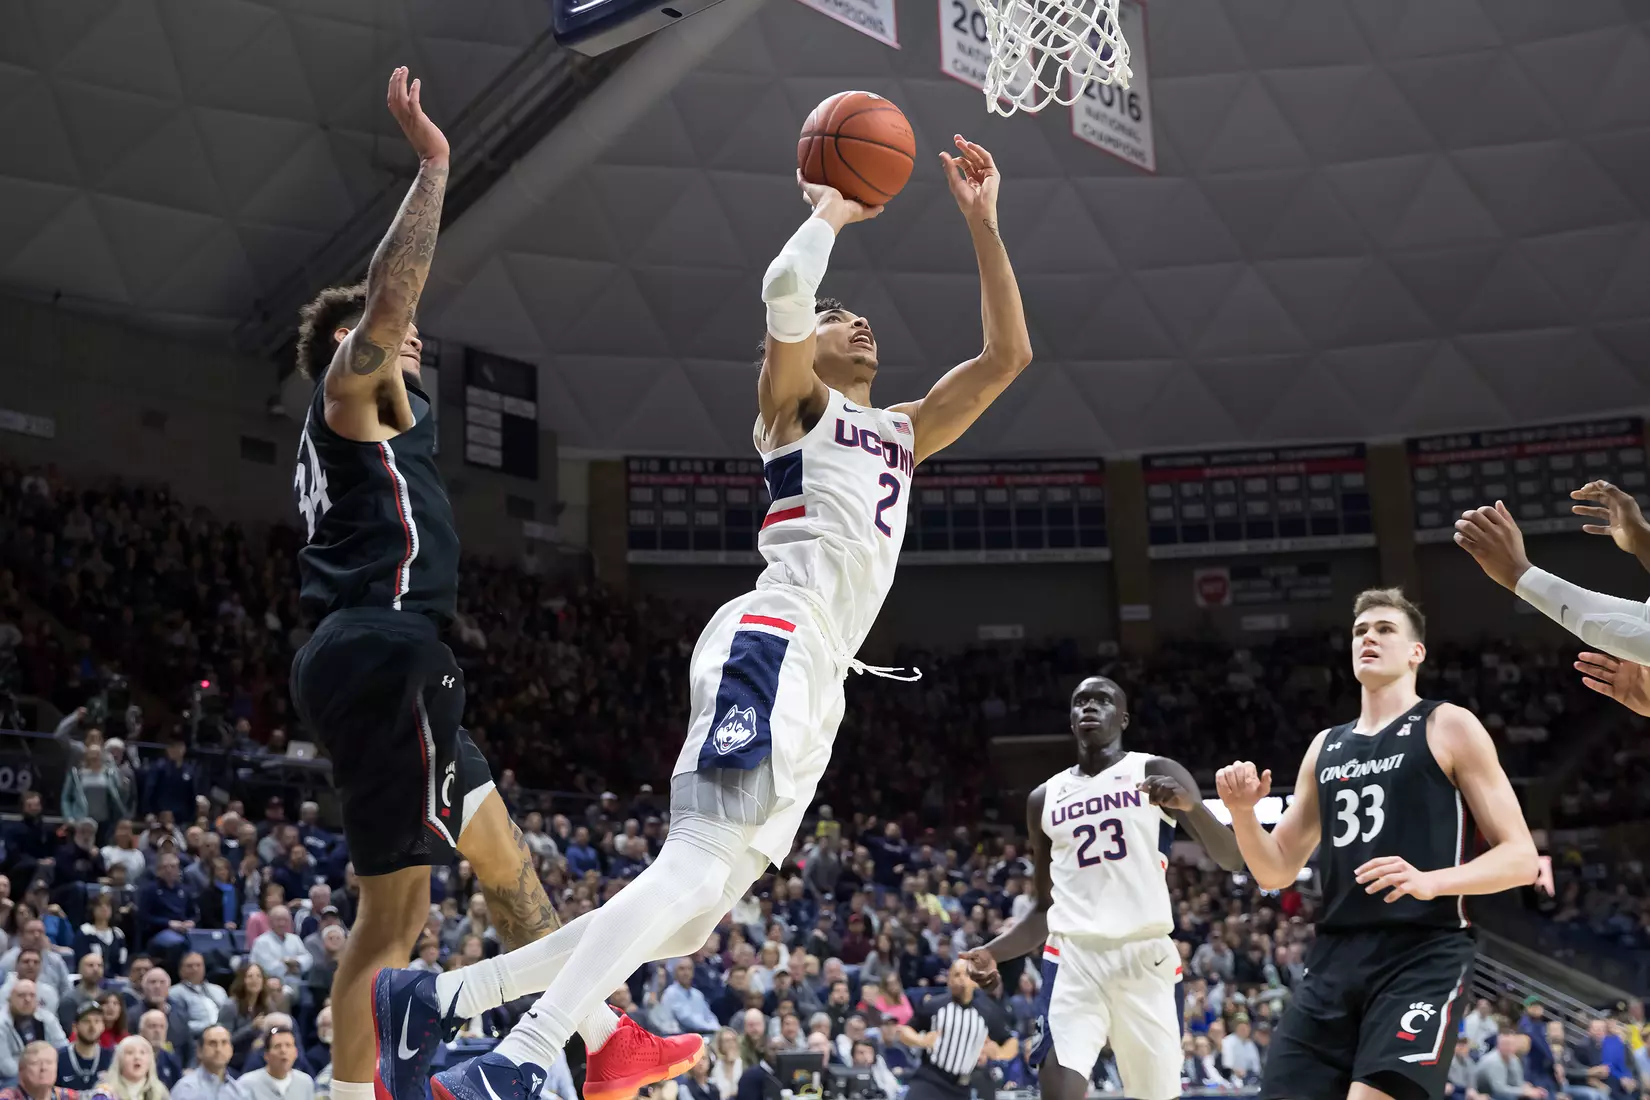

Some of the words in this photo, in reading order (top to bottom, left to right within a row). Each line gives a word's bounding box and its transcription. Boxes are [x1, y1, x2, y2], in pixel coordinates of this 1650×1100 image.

[1082, 68, 1142, 123] 2016
[1082, 121, 1148, 164] CHAMPIONS
[1085, 105, 1143, 145] NATIONAL
[834, 418, 914, 479] UCONN
[874, 472, 901, 539] 2
[1320, 753, 1405, 785] CINCINNATI
[1051, 790, 1142, 827] UCONN
[1332, 784, 1386, 848] 33
[1073, 818, 1127, 869] 23
